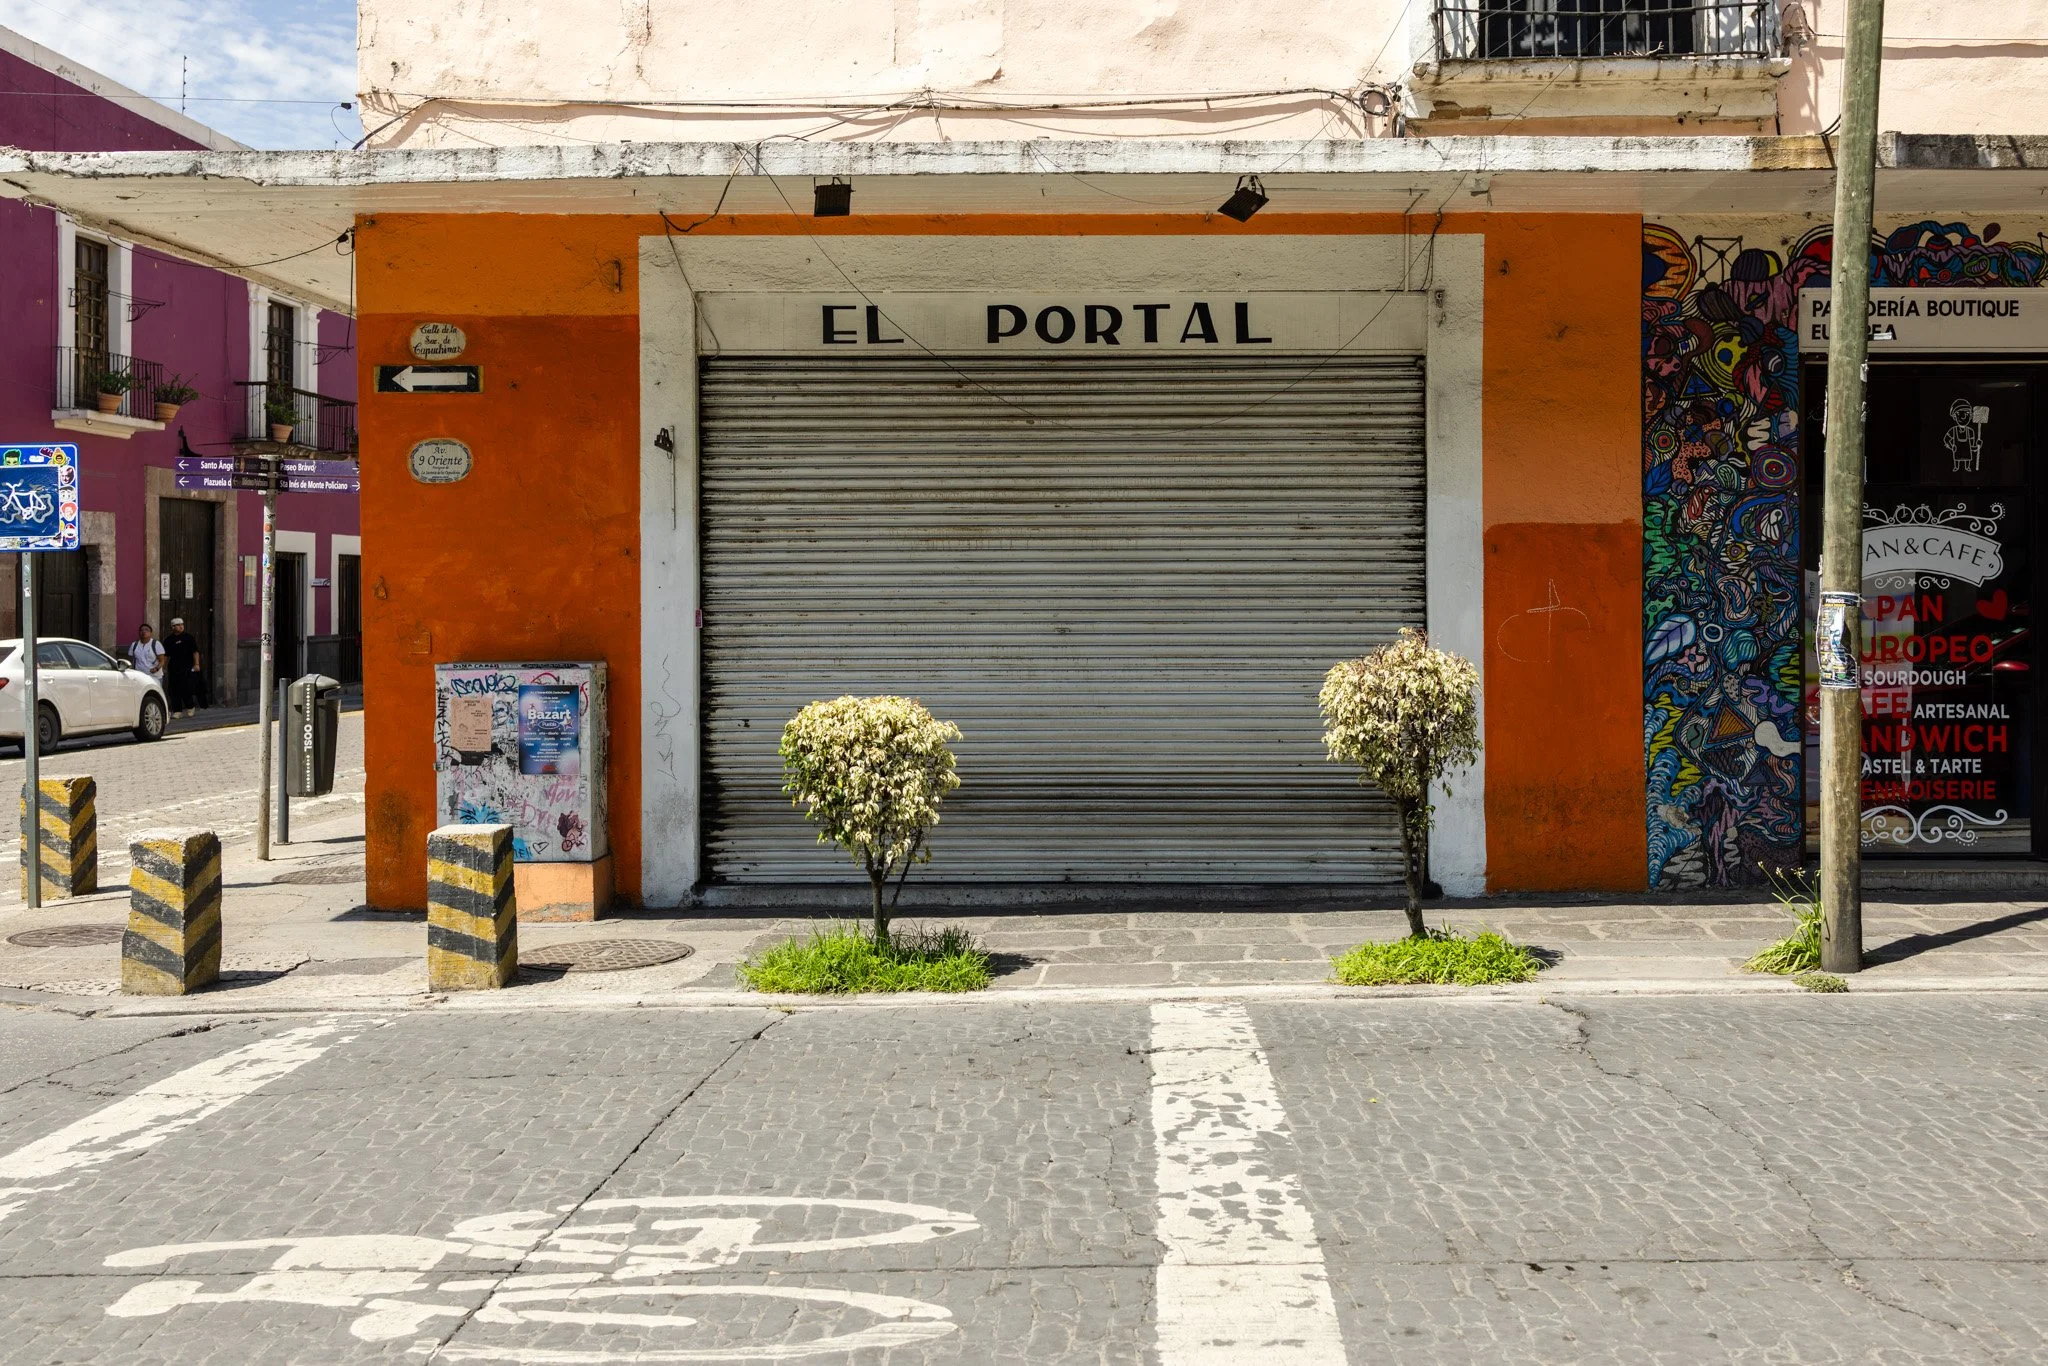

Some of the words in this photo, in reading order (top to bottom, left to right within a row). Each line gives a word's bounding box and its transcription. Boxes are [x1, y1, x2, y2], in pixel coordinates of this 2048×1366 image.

[1812, 295, 1920, 318] PADERÍA
[1927, 300, 2020, 319] BOUTIQUE
[822, 304, 905, 344] EL
[986, 302, 1273, 345] PORTAL
[433, 446, 447, 454] Av.
[200, 460, 217, 470] Santo
[218, 459, 234, 471] Ánge
[280, 463, 297, 472] Paseo
[418, 455, 426, 466] 9
[427, 455, 463, 466] Oriente
[203, 477, 227, 487] Plazuela
[288, 478, 300, 489] Inés
[300, 480, 307, 488] de
[307, 480, 325, 489] Monte
[1865, 537, 1986, 567] AN&CAFE
[1877, 594, 1944, 622] PAN
[1860, 634, 1994, 664] UROPEO
[1864, 670, 1967, 686] SOURDOUGH
[527, 709, 572, 720] Bazart
[1913, 703, 2010, 719] ARTESANAL
[1861, 758, 1911, 774] ASTEL
[1915, 758, 1927, 774] &
[1929, 758, 1982, 774] TARTE
[1860, 779, 1997, 801] ENNOISERIE
